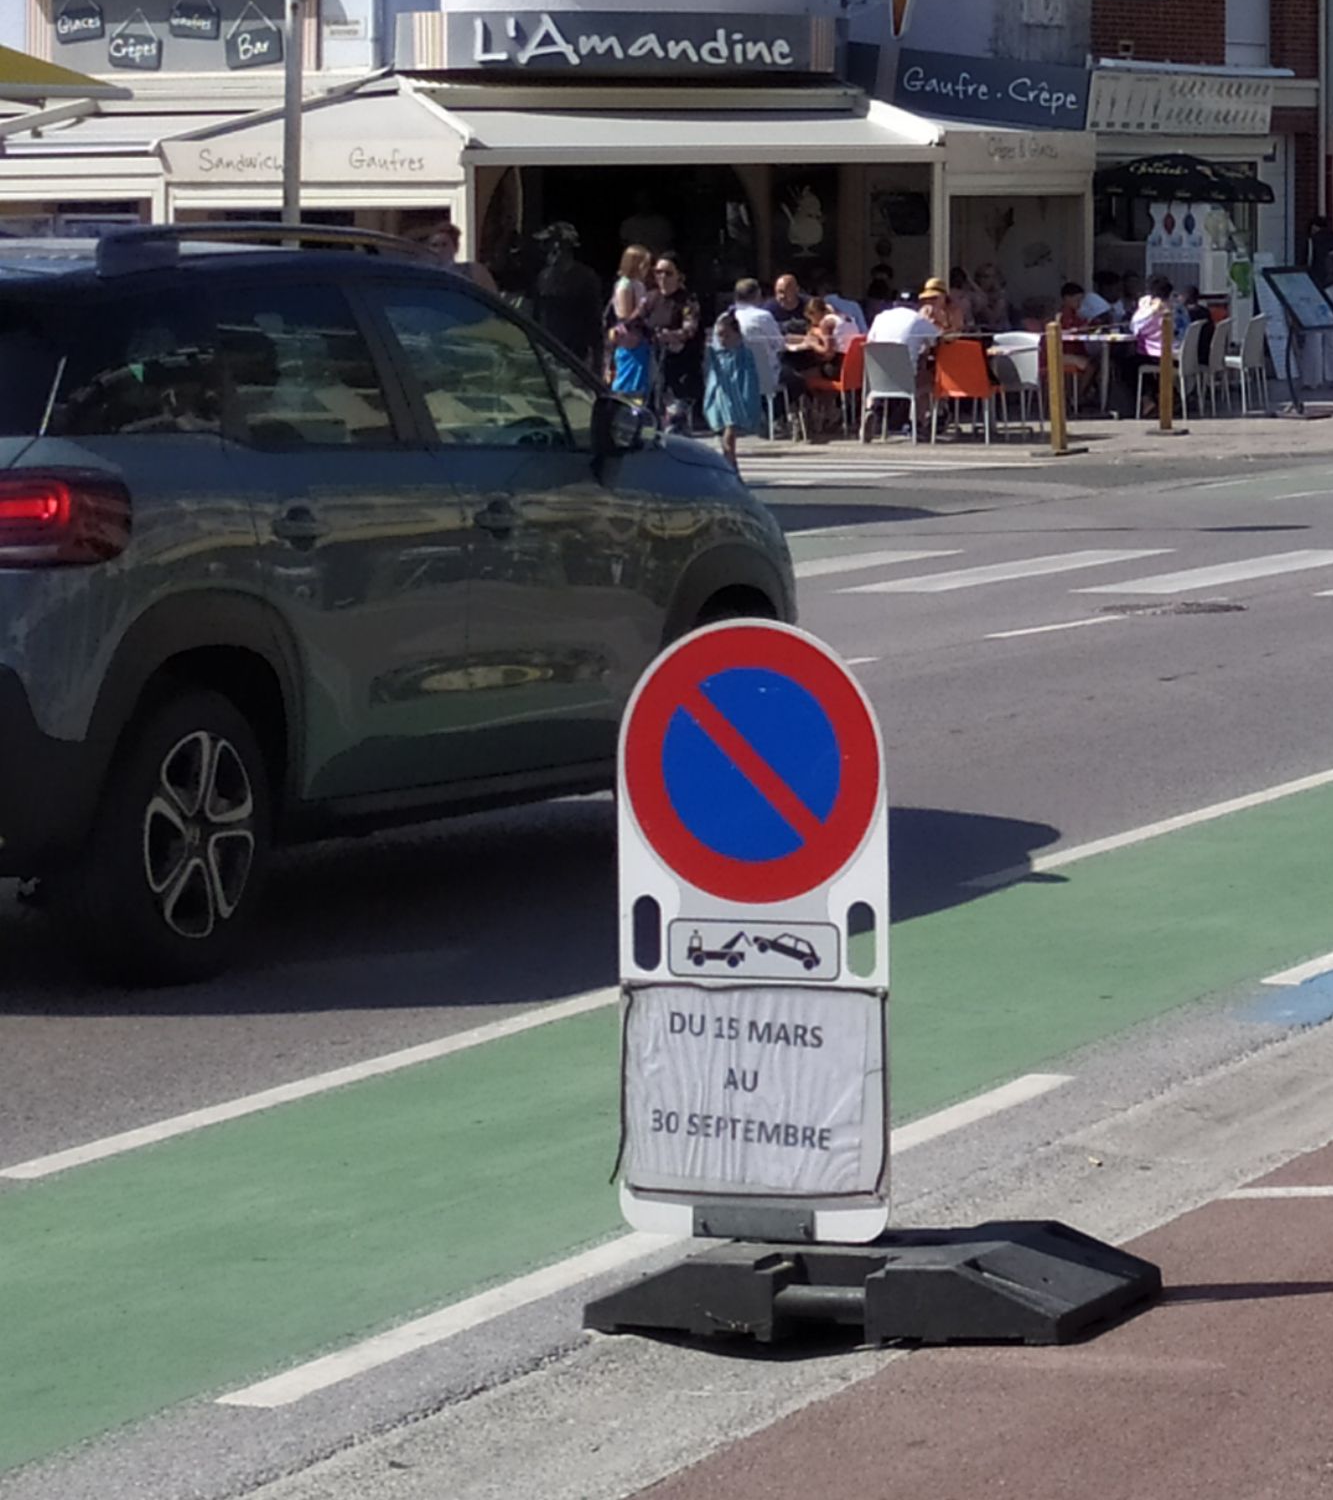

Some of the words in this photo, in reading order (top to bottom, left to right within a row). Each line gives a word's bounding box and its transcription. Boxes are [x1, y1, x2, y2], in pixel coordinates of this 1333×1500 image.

[56, 14, 101, 35] Glaces
[110, 38, 158, 64] Crêpes
[238, 34, 270, 61] Bar
[473, 13, 794, 66] L'Amandine
[903, 66, 989, 100] Gaufre
[1008, 77, 1079, 115] Crêpe
[349, 146, 425, 171] Gaufres
[669, 1011, 706, 1037] DU
[714, 1016, 740, 1040] 15
[748, 1020, 824, 1049] MARS
[723, 1067, 759, 1093] AU
[651, 1109, 680, 1135] 30
[686, 1112, 832, 1151] SEPTEMBRE
